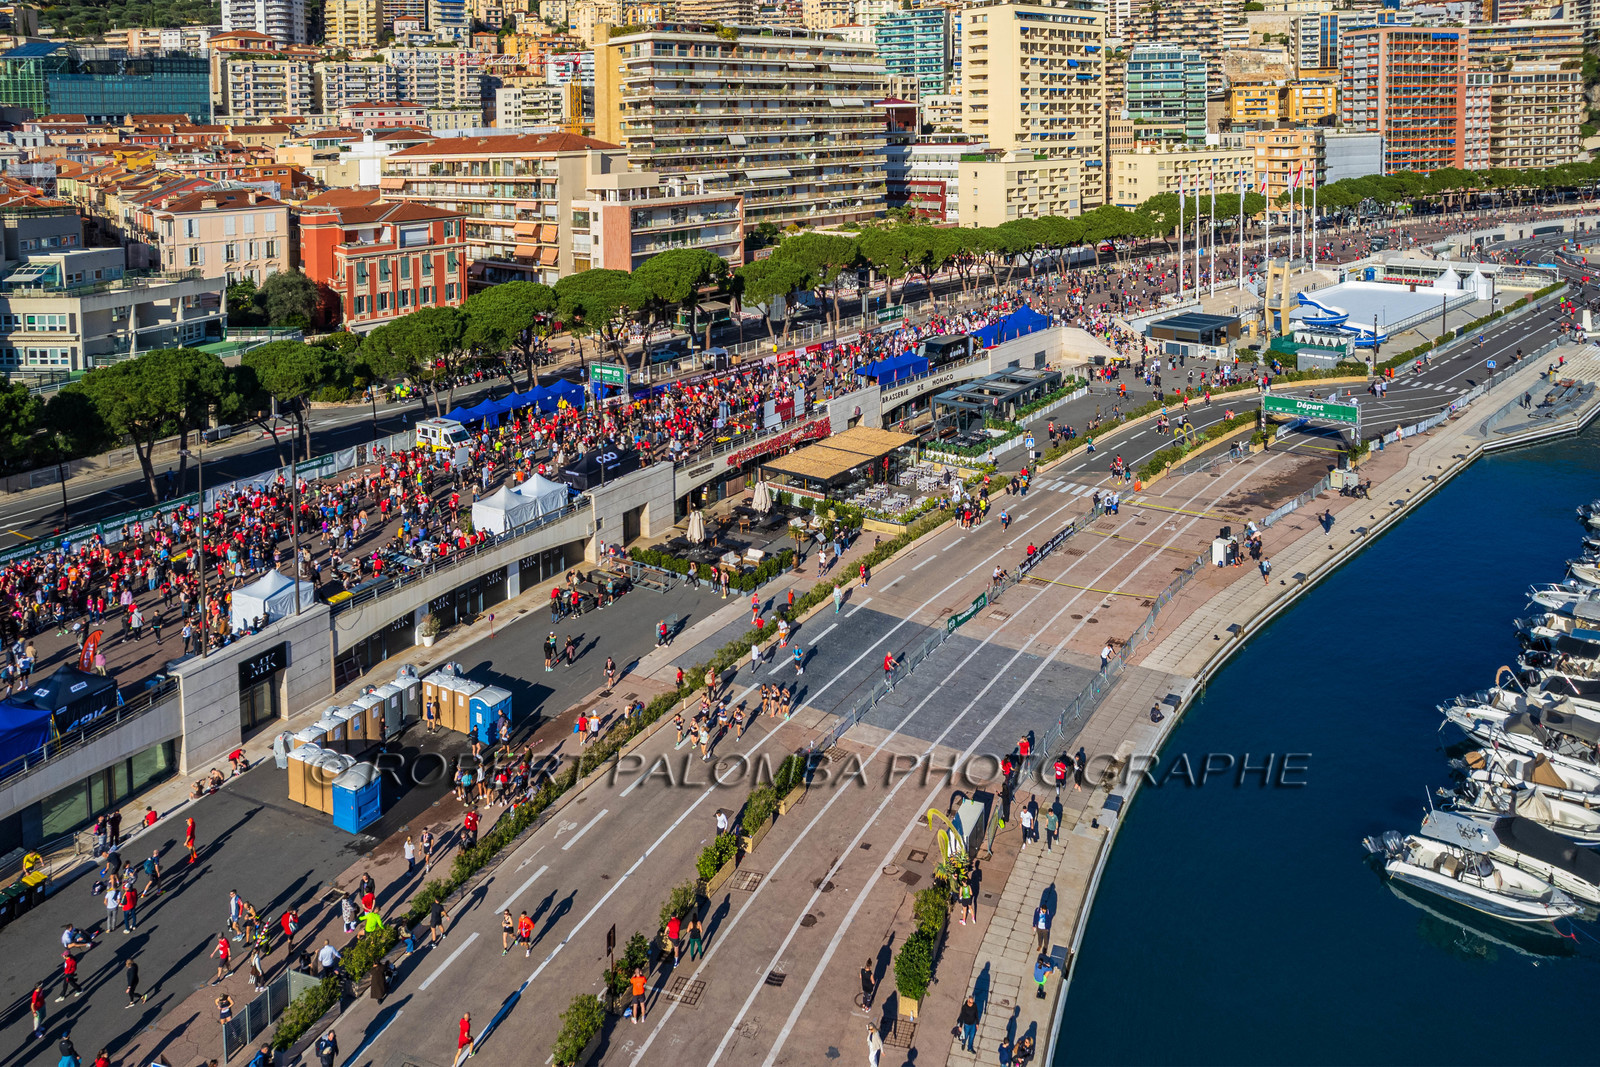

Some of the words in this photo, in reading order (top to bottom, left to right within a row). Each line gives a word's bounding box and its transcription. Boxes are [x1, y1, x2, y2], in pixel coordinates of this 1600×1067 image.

[882, 388, 909, 404] BRASSERIE
[917, 383, 925, 392] DE
[931, 374, 954, 387] MONACO
[1296, 401, 1324, 411] Départ
[249, 651, 277, 679] MK
